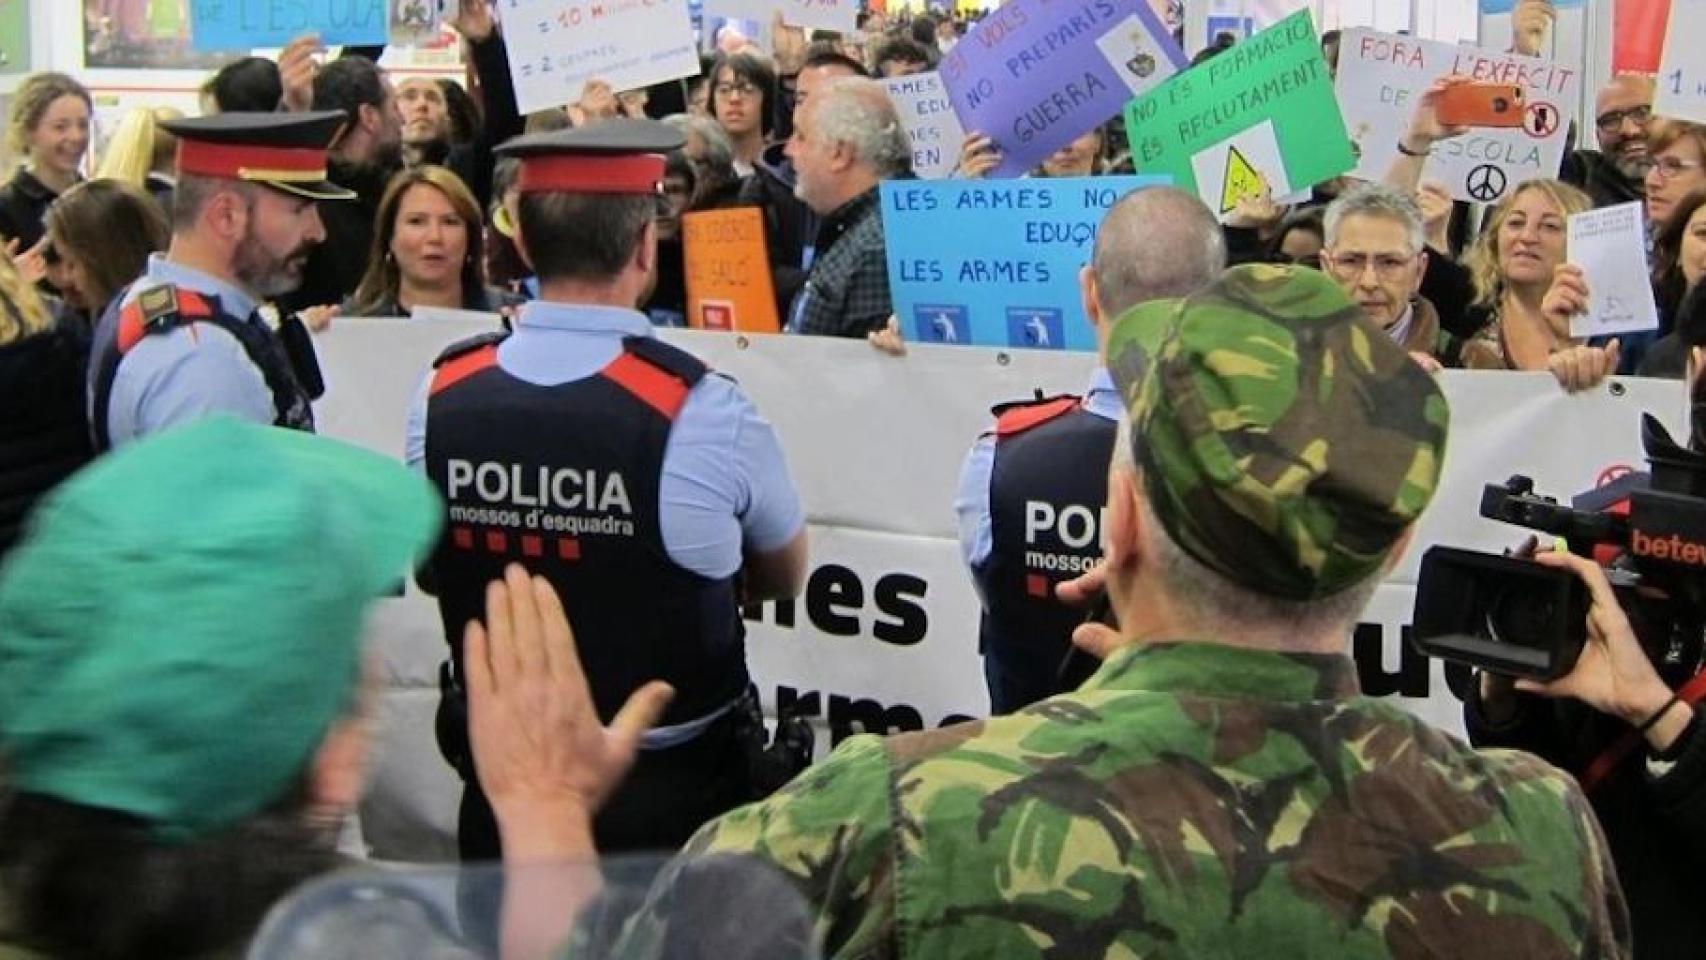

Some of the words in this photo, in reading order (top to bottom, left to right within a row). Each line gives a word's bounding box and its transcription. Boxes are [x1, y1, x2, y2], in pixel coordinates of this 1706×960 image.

[976, 4, 1028, 48] VOLS
[965, 78, 995, 111] NO
[1005, 2, 1115, 78] PREPARIS
[1360, 36, 1425, 69] FORA
[888, 79, 938, 94] RMES
[1178, 56, 1320, 145] RECLUTAMENT
[1013, 71, 1107, 143] GUERRA
[1132, 98, 1158, 126] NO
[892, 189, 938, 211] LES
[956, 188, 1053, 209] ARMES
[1084, 187, 1118, 209] NO
[1025, 222, 1096, 248] EDUQ
[899, 259, 943, 282] LES
[959, 260, 1050, 284] ARMES
[447, 458, 633, 515] POLICIA
[450, 506, 521, 528] mossos
[526, 510, 635, 537] d'esquadra
